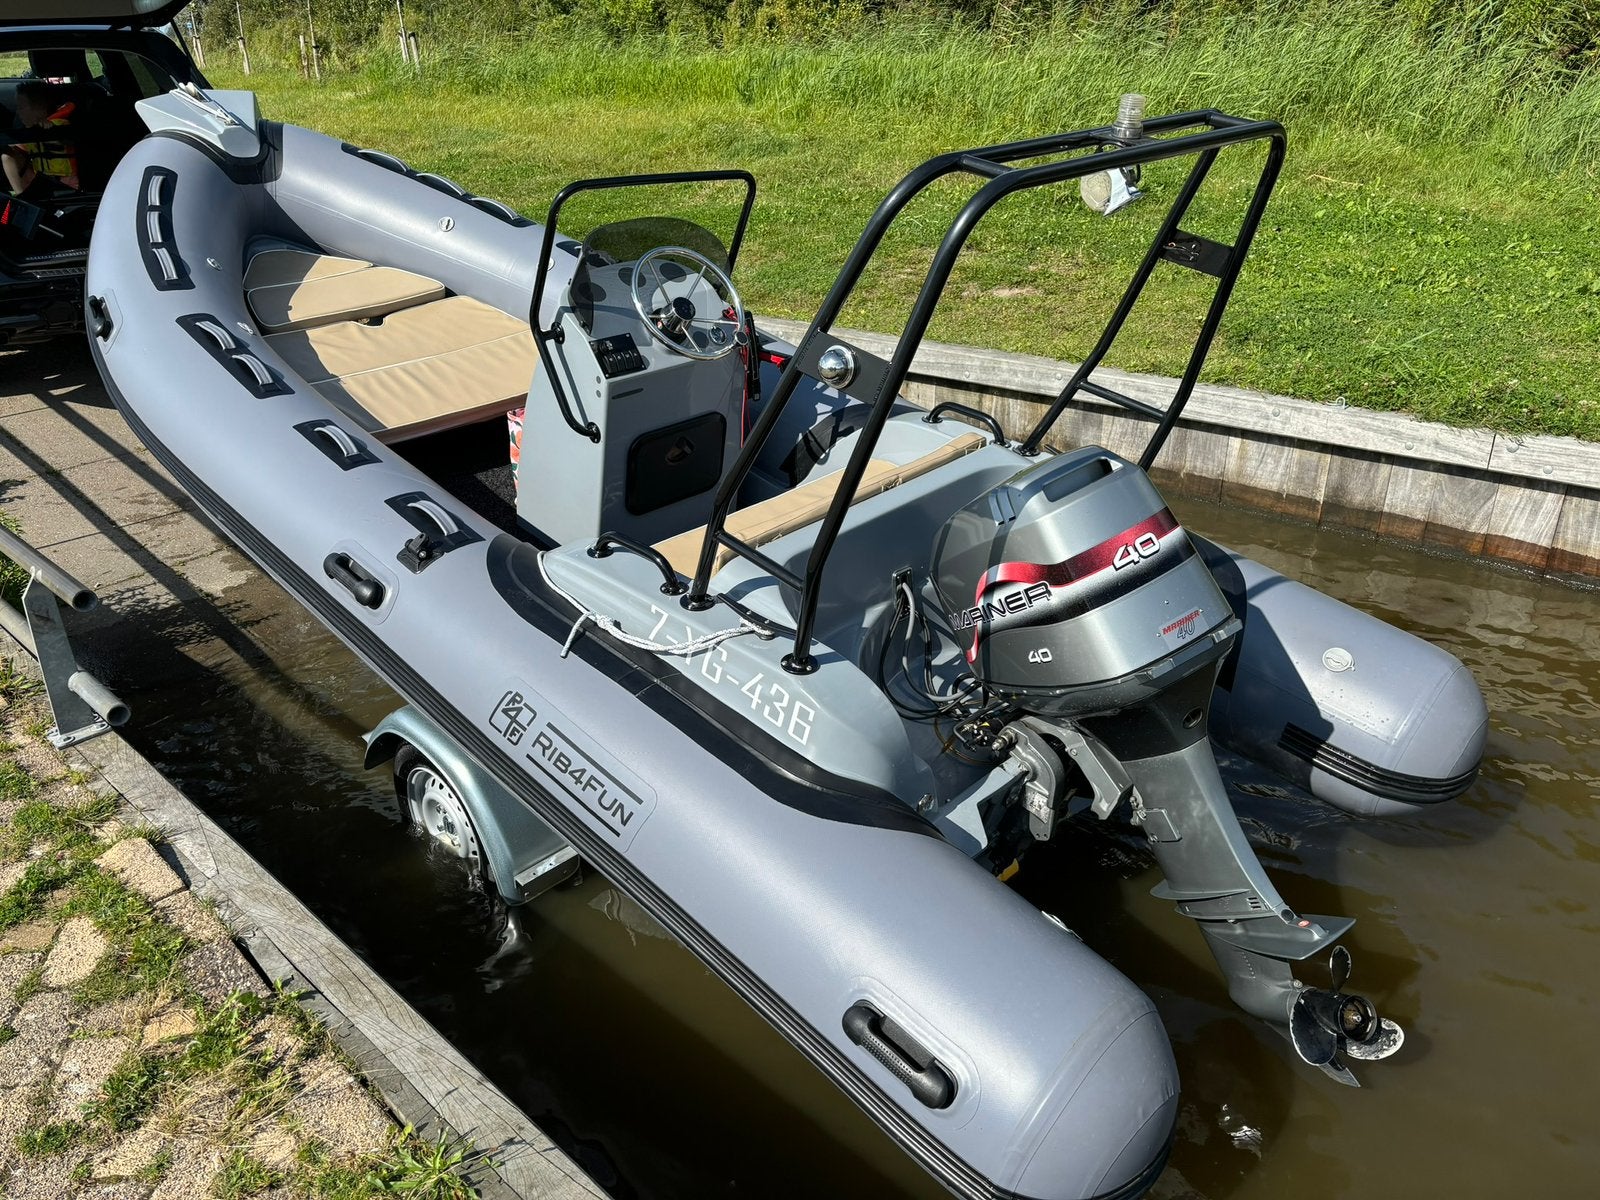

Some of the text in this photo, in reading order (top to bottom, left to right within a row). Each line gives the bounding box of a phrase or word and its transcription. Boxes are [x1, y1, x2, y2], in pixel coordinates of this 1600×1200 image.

[1113, 532, 1160, 570] 40
[1162, 610, 1200, 635] MARINER
[1177, 618, 1195, 639] 40
[1028, 648, 1052, 664] 40
[531, 731, 634, 827] RIB4FUN
